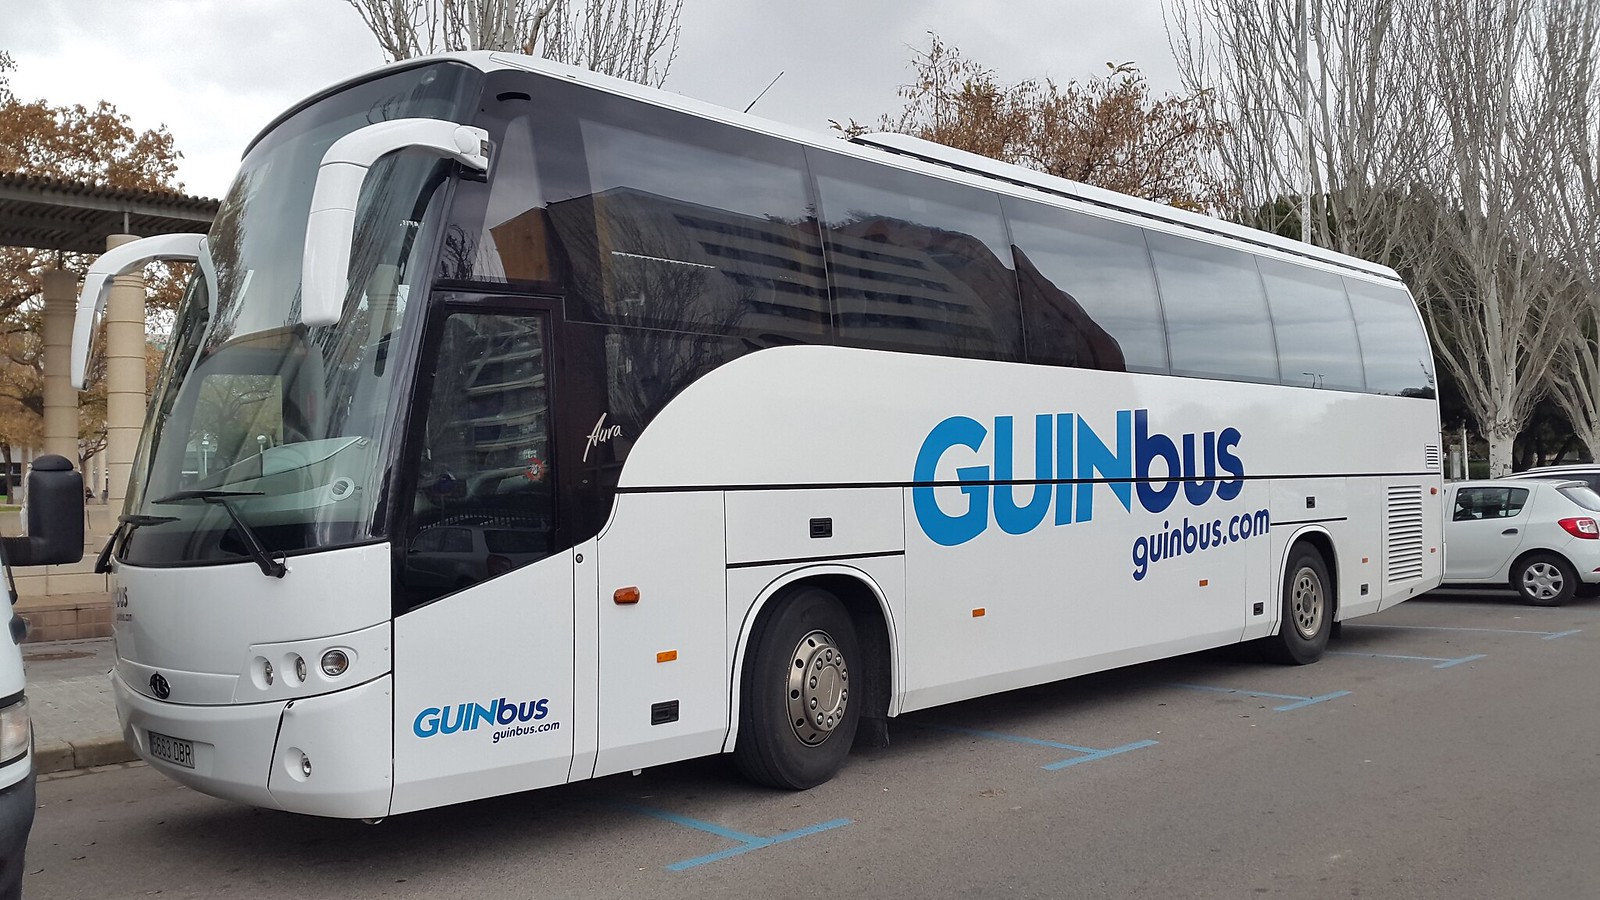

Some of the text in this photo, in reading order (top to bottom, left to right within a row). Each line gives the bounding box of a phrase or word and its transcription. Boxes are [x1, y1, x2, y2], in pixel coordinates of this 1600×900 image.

[583, 412, 622, 462] Aura
[912, 408, 1245, 547] GUINbus
[1132, 508, 1270, 581] guinbus.com
[413, 697, 549, 738] GUINbus
[492, 721, 560, 744] guinbus.com
[174, 741, 192, 765] DBR
